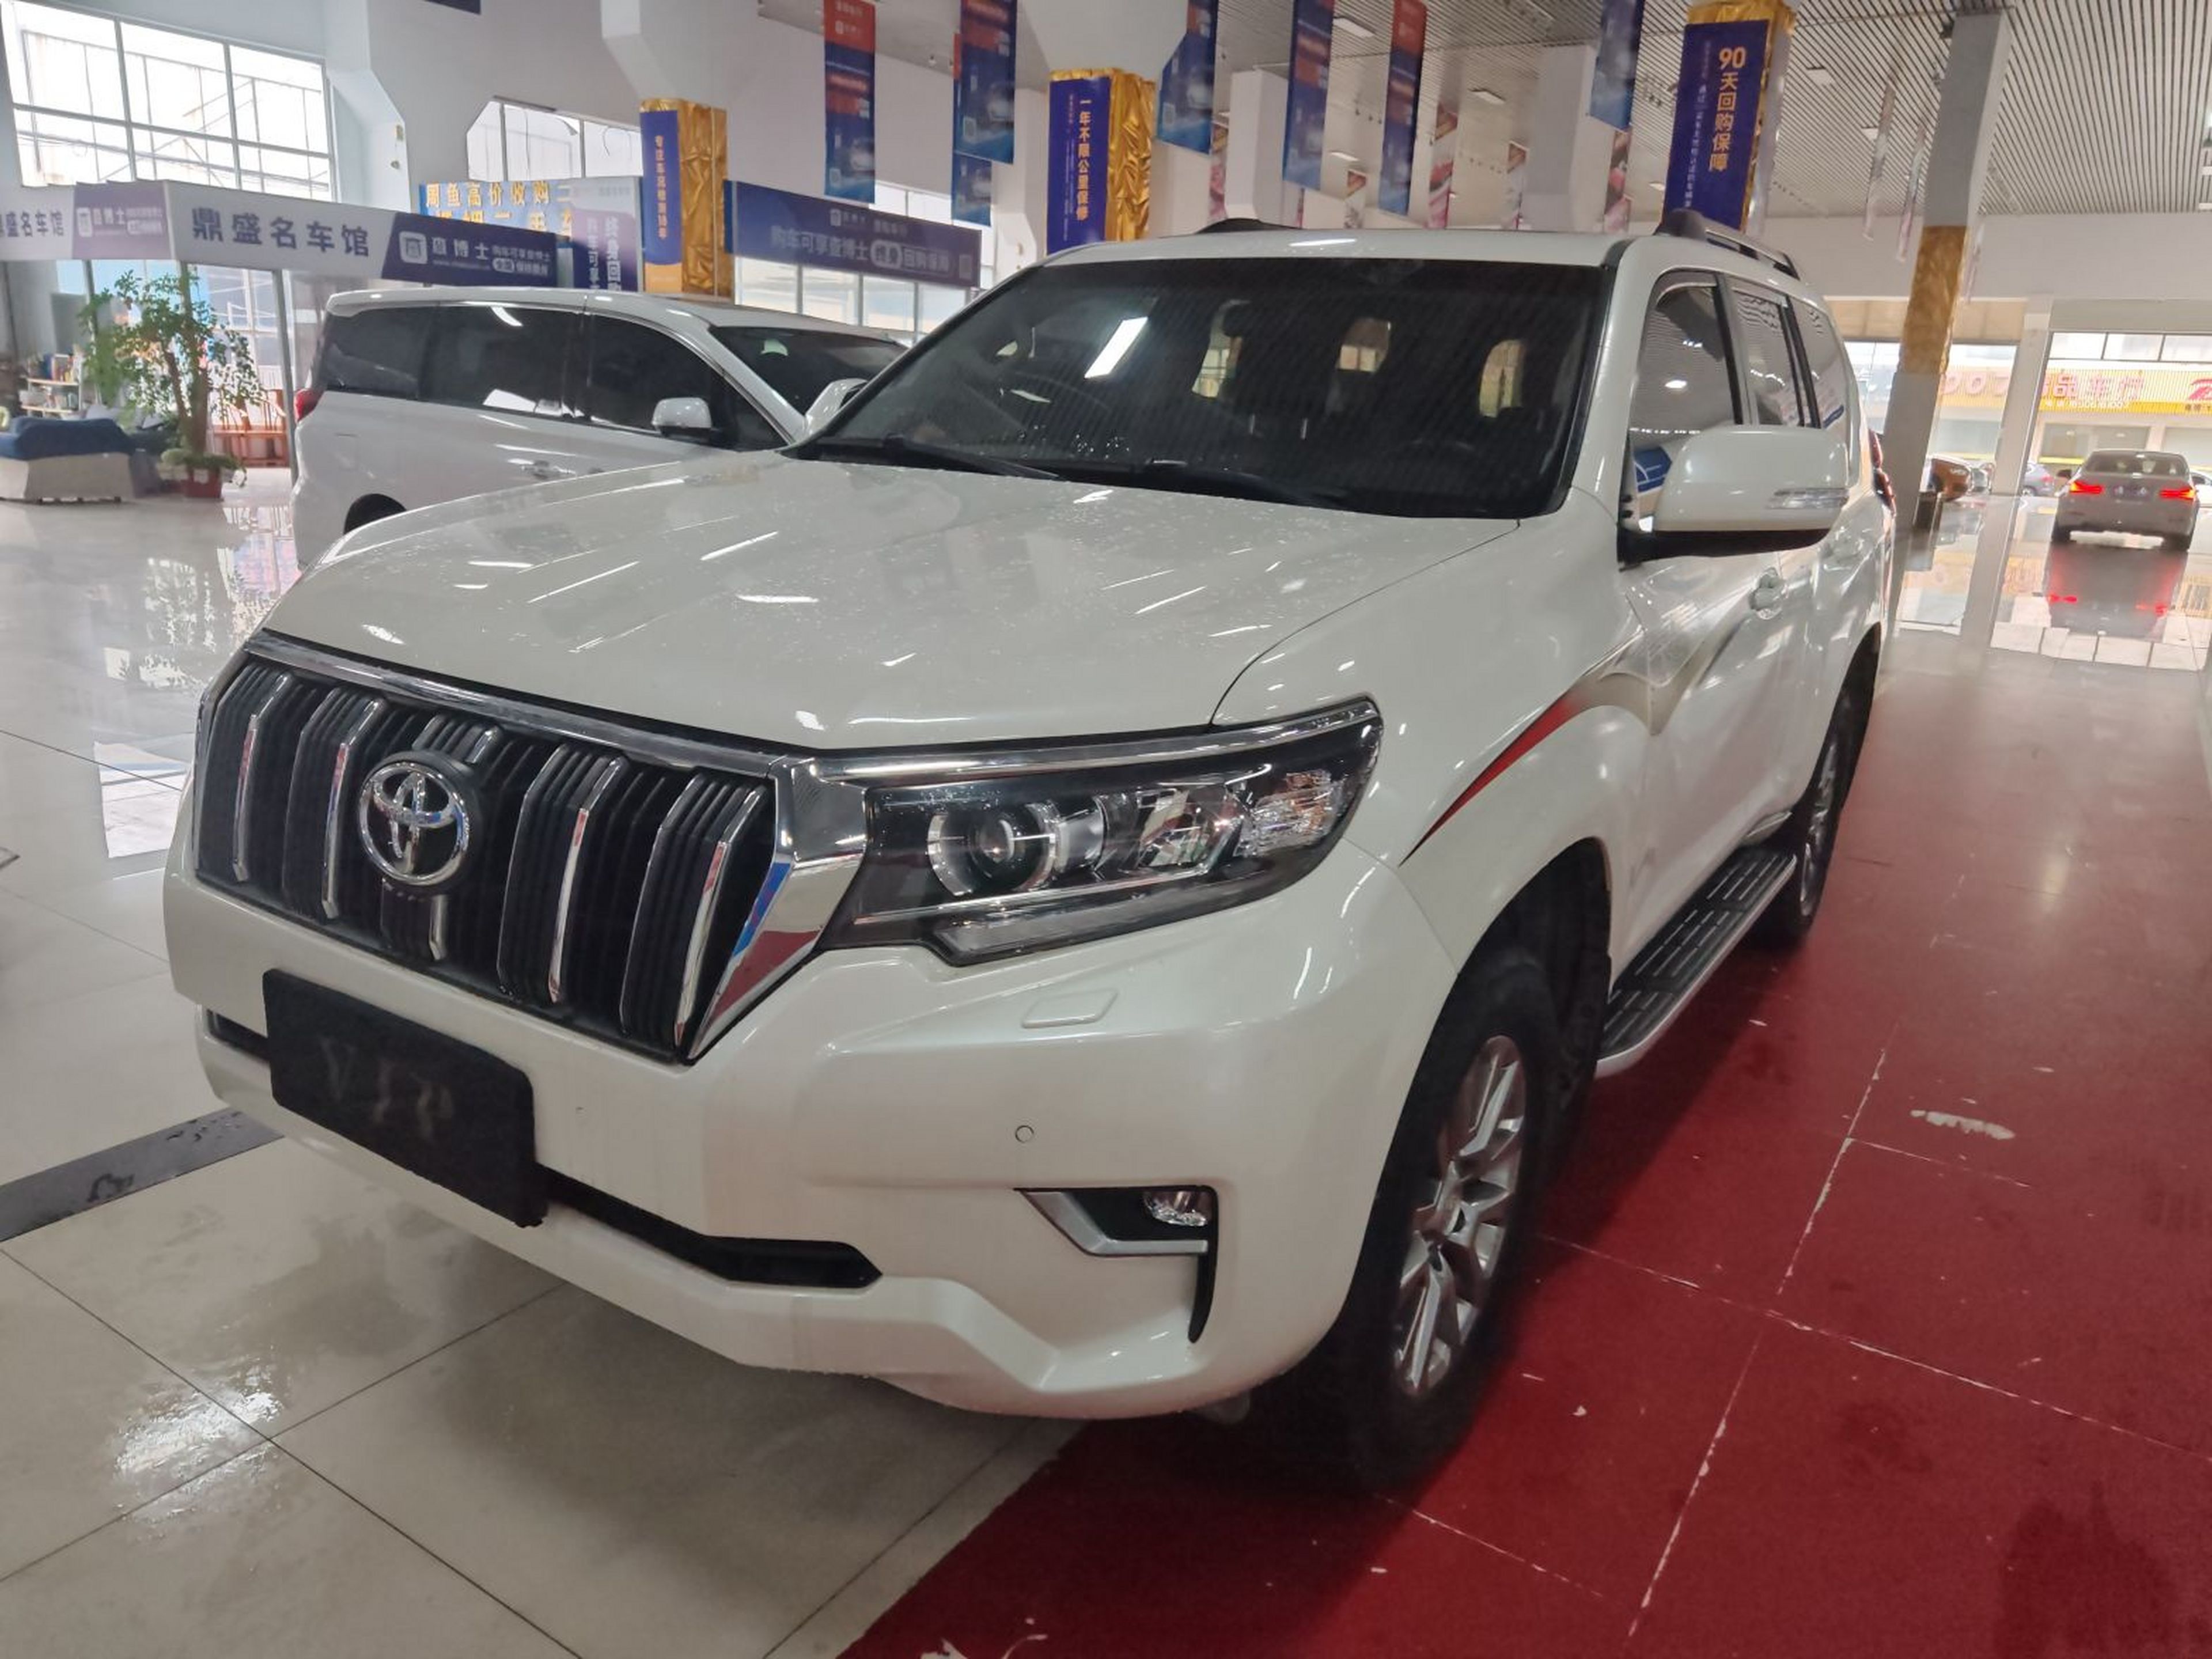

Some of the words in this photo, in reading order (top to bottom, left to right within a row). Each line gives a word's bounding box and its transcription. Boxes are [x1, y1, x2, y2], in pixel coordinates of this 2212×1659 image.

[1709, 47, 1747, 172] 90天回购保障
[0, 211, 64, 237] 盛名车馆
[191, 207, 369, 257] 鼎盛名车馆
